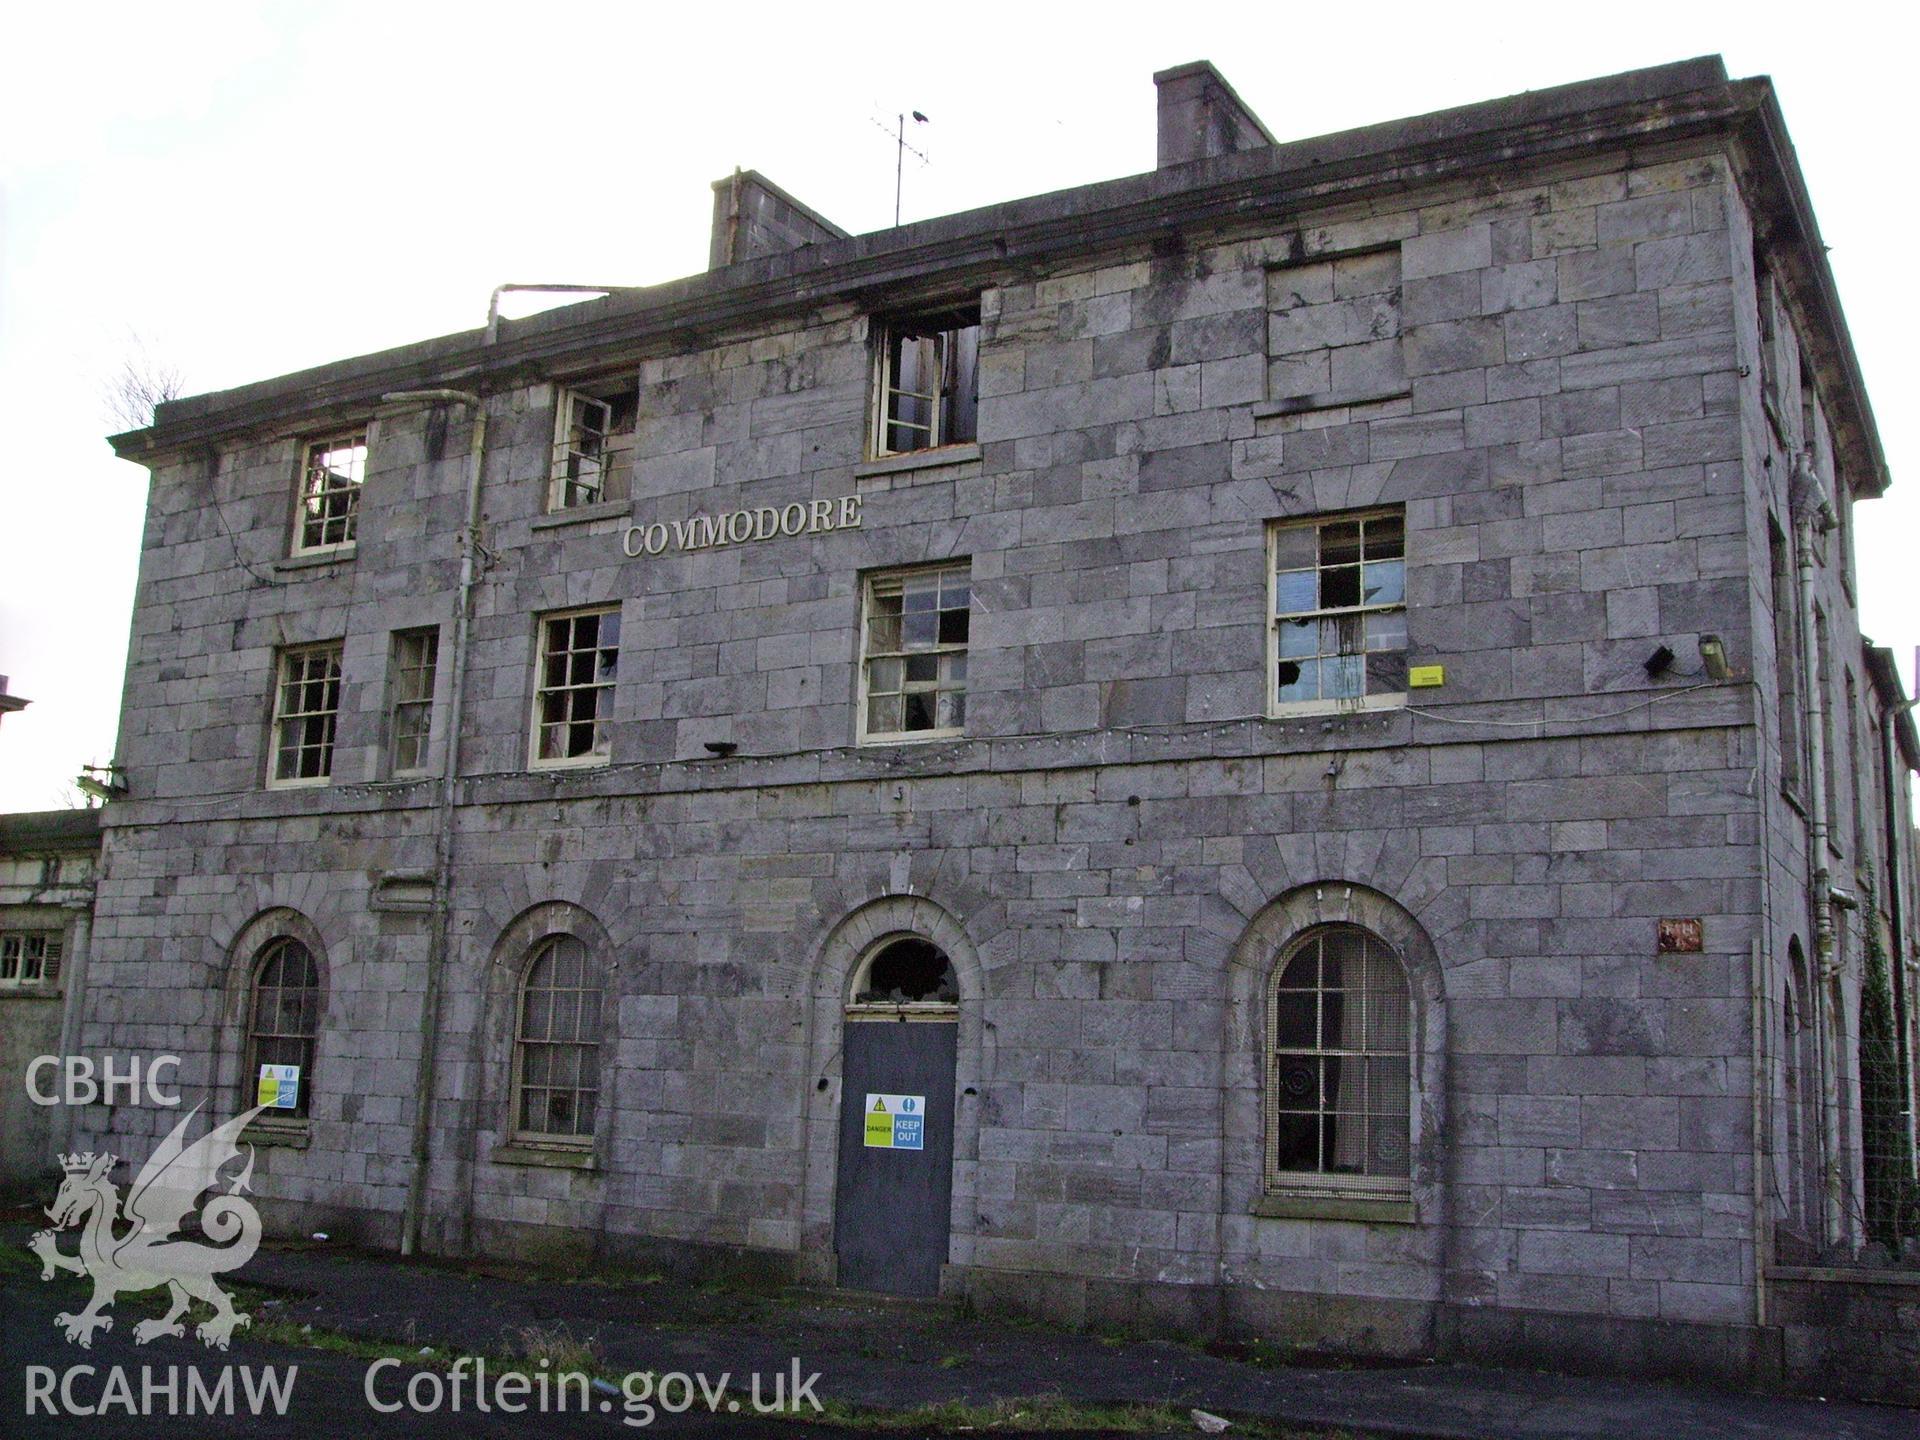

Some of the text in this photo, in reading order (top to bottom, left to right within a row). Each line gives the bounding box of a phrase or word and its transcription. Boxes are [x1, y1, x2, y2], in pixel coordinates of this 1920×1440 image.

[623, 495, 862, 557] COMMODORE
[866, 1125, 892, 1133] DANGER
[896, 1120, 920, 1131] KEEP
[897, 1132, 917, 1141] OUT
